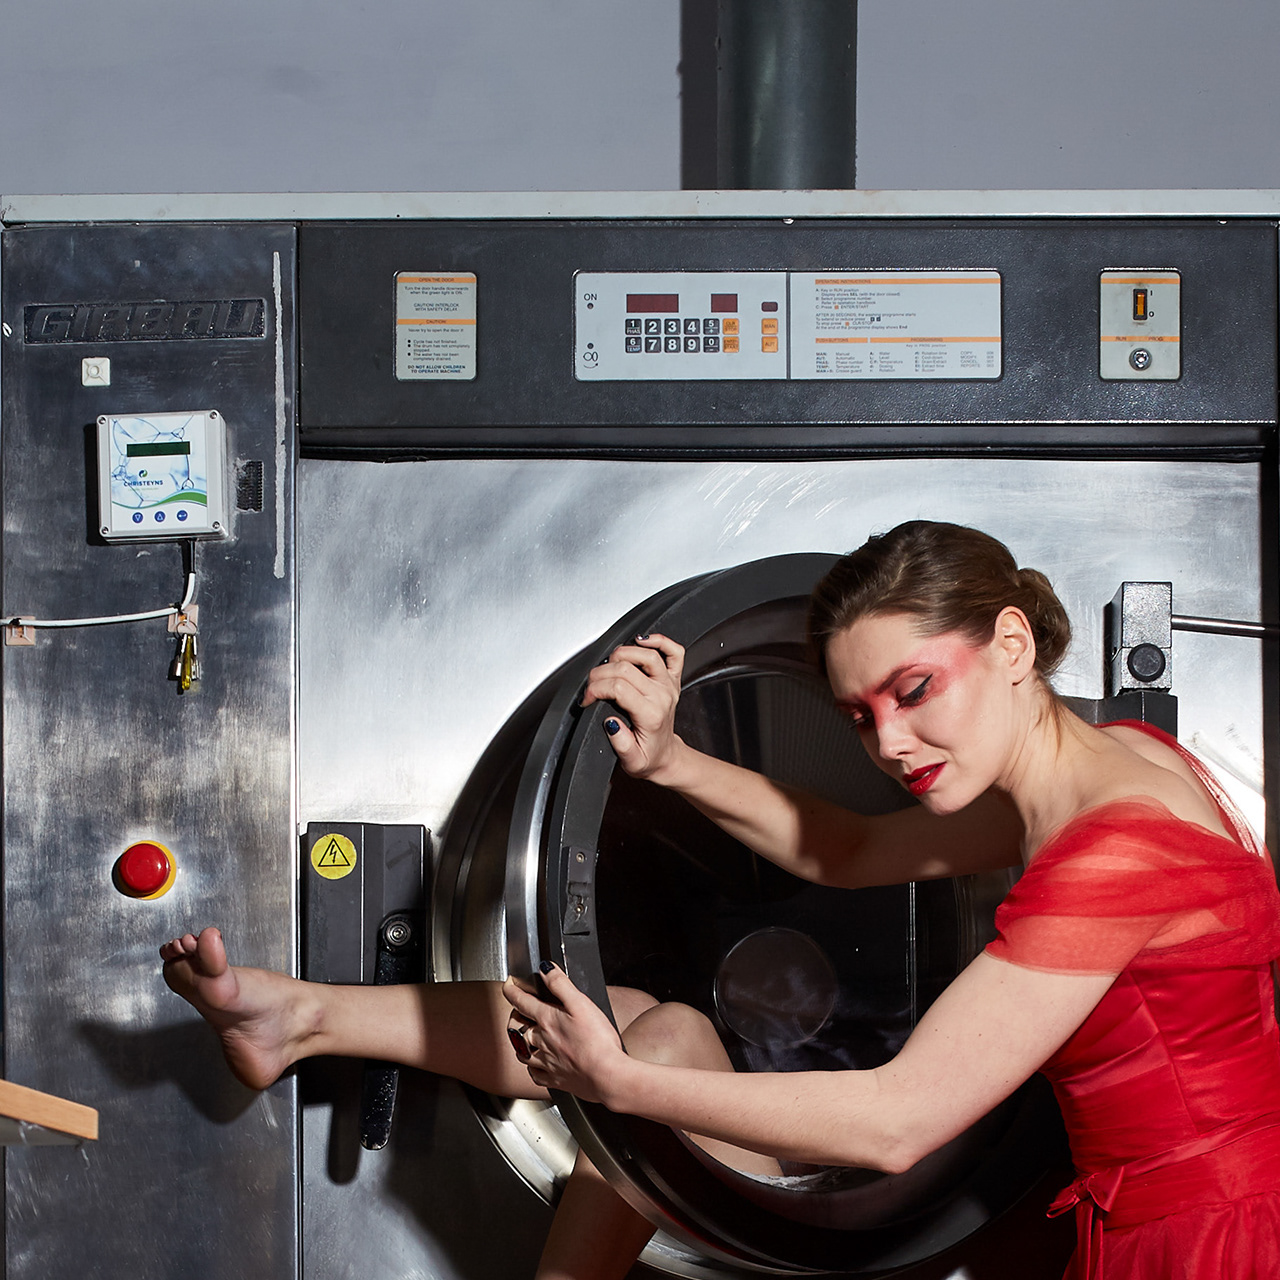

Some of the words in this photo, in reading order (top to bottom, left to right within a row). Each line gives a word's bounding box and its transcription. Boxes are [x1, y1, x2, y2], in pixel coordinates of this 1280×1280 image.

[31, 302, 258, 339] GIRBAU
[648, 321, 658, 333] 2
[668, 321, 678, 333] 3
[687, 321, 697, 333] 4
[630, 338, 636, 346] 6
[648, 339, 658, 351] 7
[668, 339, 678, 351] 8
[687, 339, 697, 351] 9
